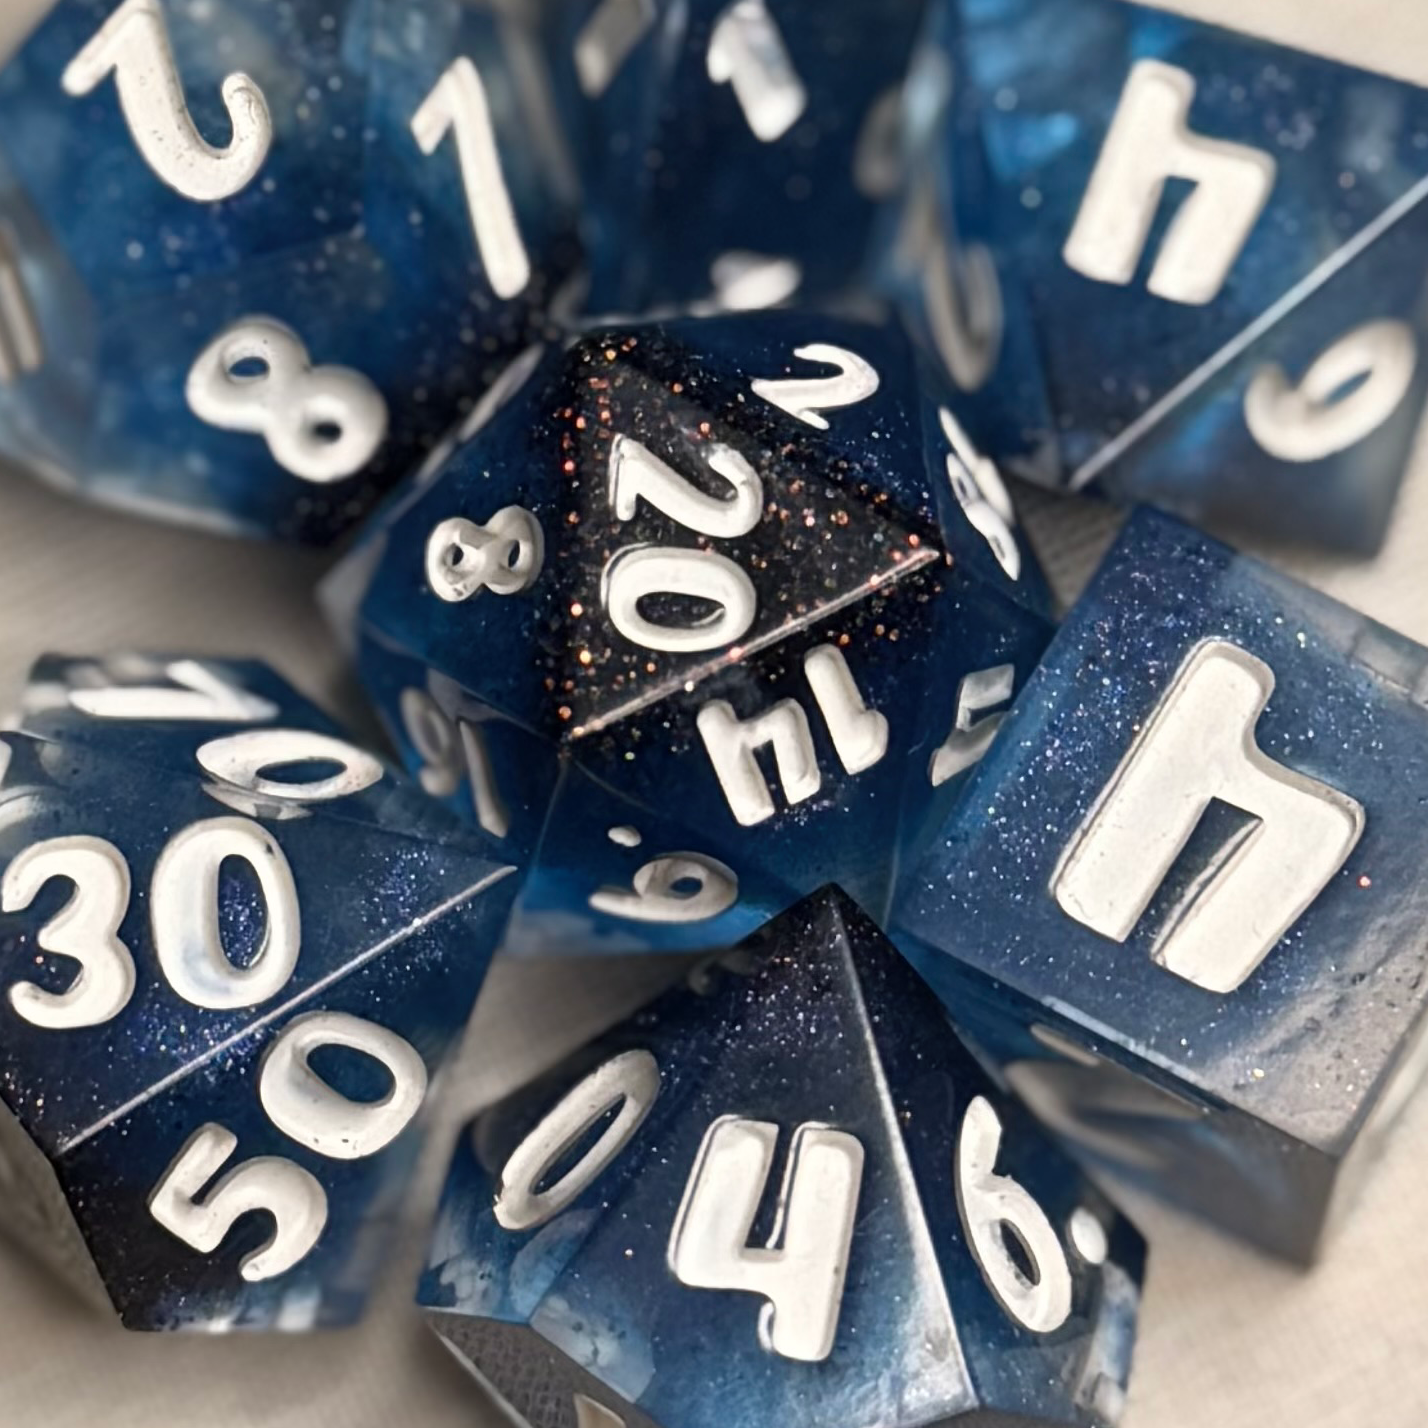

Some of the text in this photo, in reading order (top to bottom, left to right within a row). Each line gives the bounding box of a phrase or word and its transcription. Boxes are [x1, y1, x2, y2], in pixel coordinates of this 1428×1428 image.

[1062, 57, 1277, 307] 4
[185, 315, 388, 482] 8
[750, 342, 879, 430] 2
[425, 504, 546, 603] 8
[602, 432, 764, 654] 20
[697, 642, 890, 827] 14
[1049, 635, 1367, 994] 4
[0, 815, 302, 1032] 30
[147, 1009, 429, 1284] 50
[494, 1047, 662, 1232] 0
[667, 1112, 866, 1364] 4
